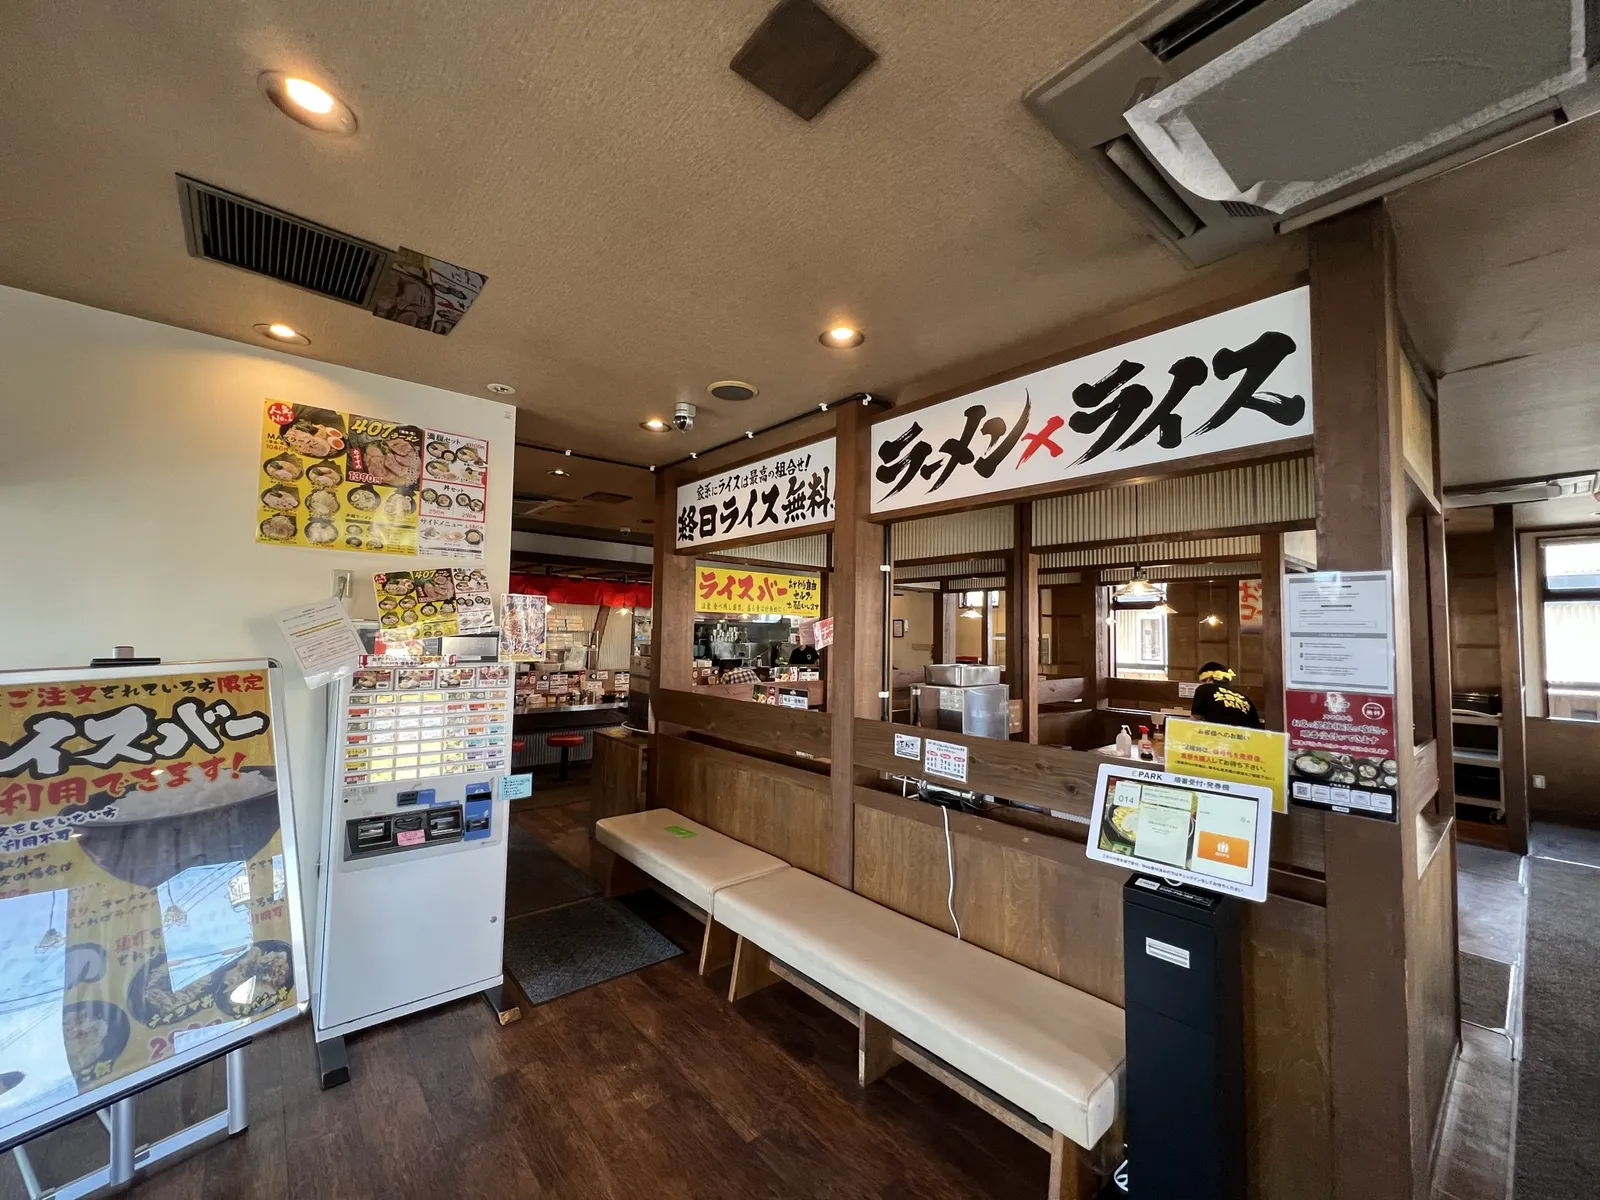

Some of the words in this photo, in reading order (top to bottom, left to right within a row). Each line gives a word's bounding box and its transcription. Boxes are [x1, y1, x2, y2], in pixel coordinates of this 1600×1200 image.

[677, 465, 836, 542] 終日ライス無料
[699, 571, 788, 602] ライスバー
[0, 673, 265, 709] ご注文されている方限定
[1131, 770, 1164, 782] EPARK
[1118, 794, 1135, 806] 014
[0, 828, 72, 852] 利用不可
